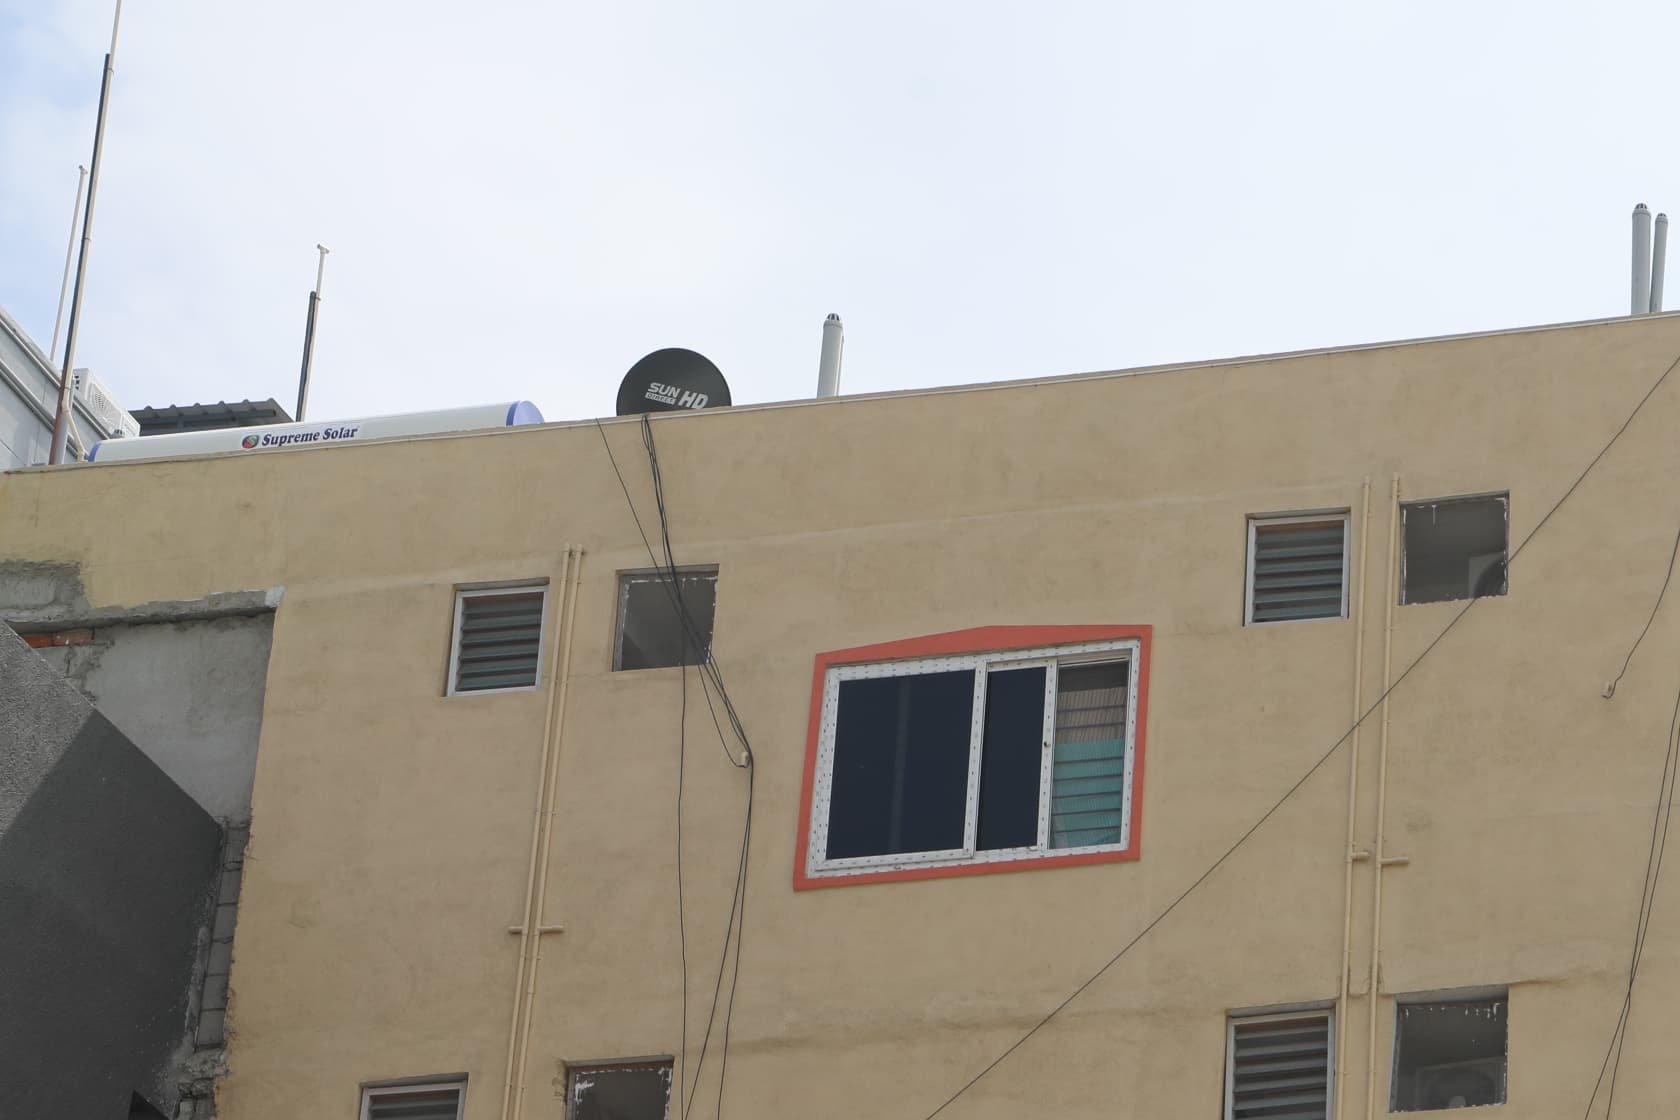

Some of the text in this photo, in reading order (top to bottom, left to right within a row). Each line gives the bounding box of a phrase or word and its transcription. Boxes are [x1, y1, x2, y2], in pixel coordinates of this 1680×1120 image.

[647, 382, 709, 409] SUN HD
[261, 426, 358, 447] Supreme Solar
